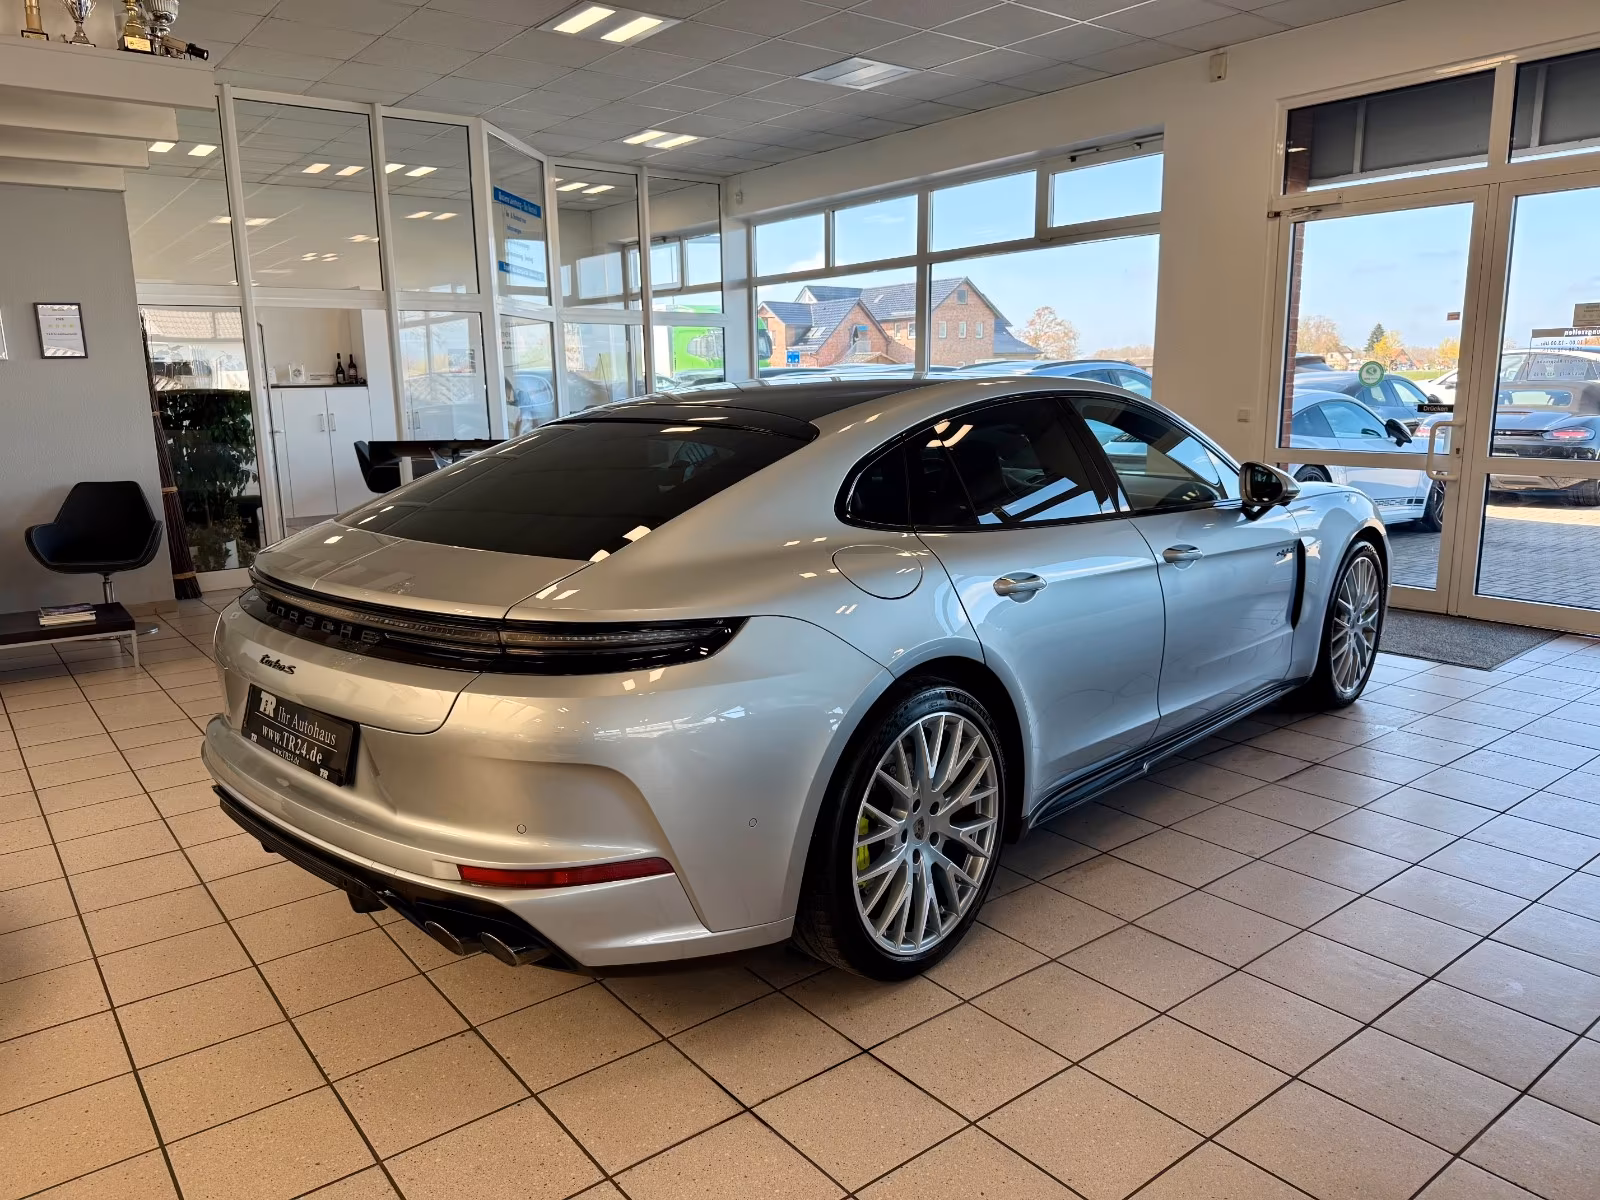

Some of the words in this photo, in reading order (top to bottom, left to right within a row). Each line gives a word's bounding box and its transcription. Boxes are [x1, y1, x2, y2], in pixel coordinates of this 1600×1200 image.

[262, 725, 323, 765] www.TR24.de
[278, 706, 291, 725] Ihr
[291, 713, 337, 746] Autohaus
